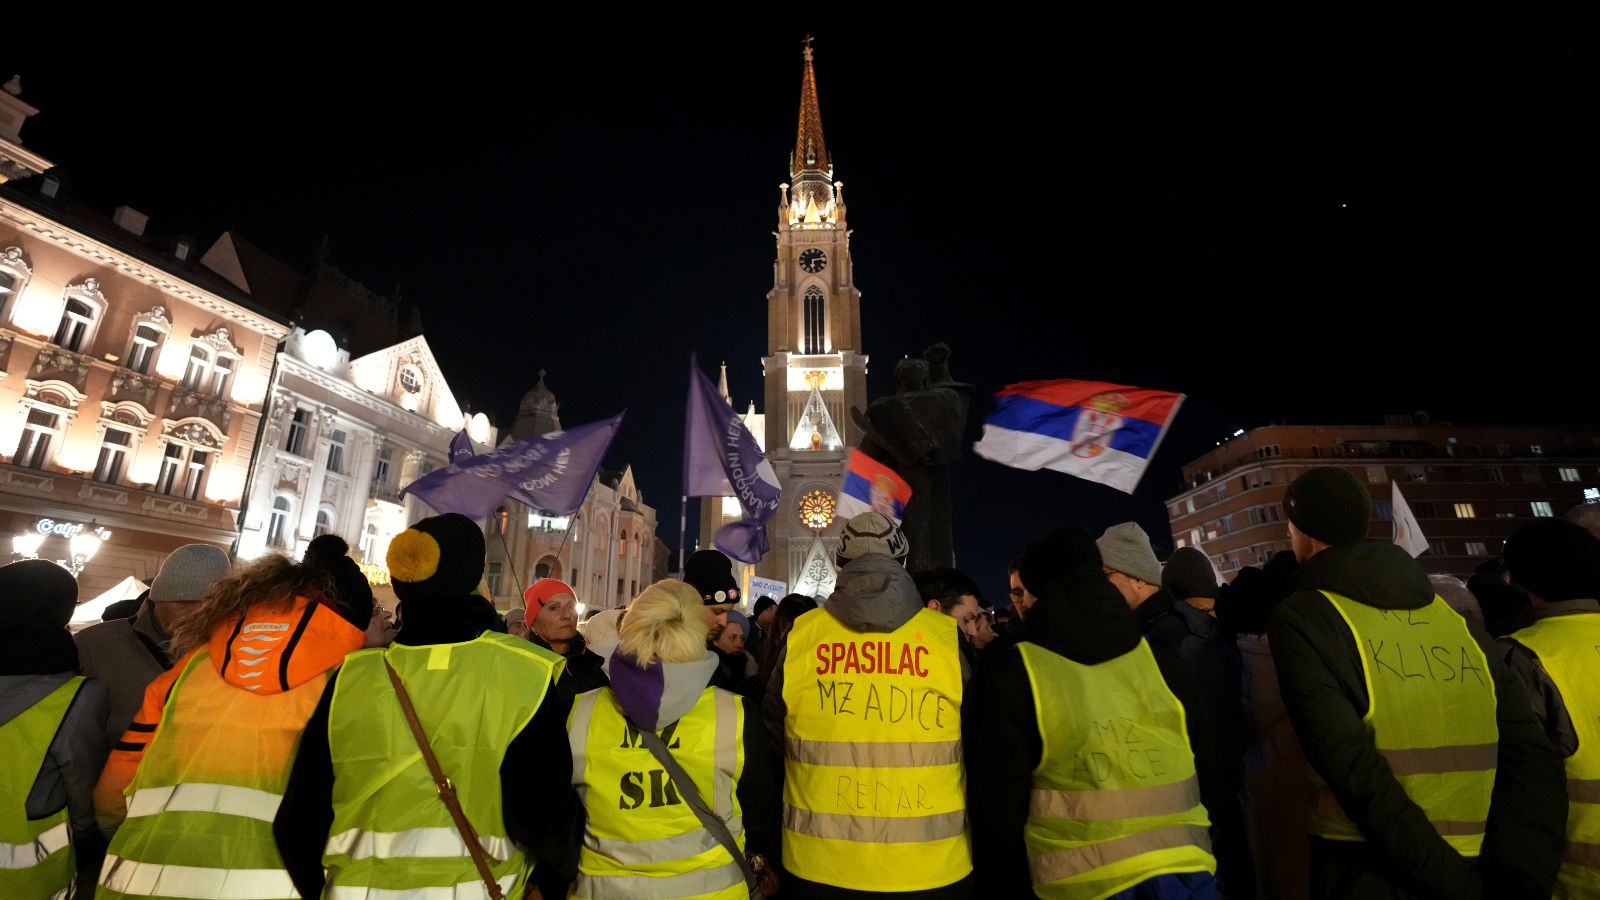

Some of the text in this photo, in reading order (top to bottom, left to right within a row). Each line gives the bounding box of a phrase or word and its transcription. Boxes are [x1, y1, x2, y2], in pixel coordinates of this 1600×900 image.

[816, 641, 929, 678] SPASILAC
[1368, 639, 1487, 688] KLISA
[816, 678, 948, 731] MZ ADICE
